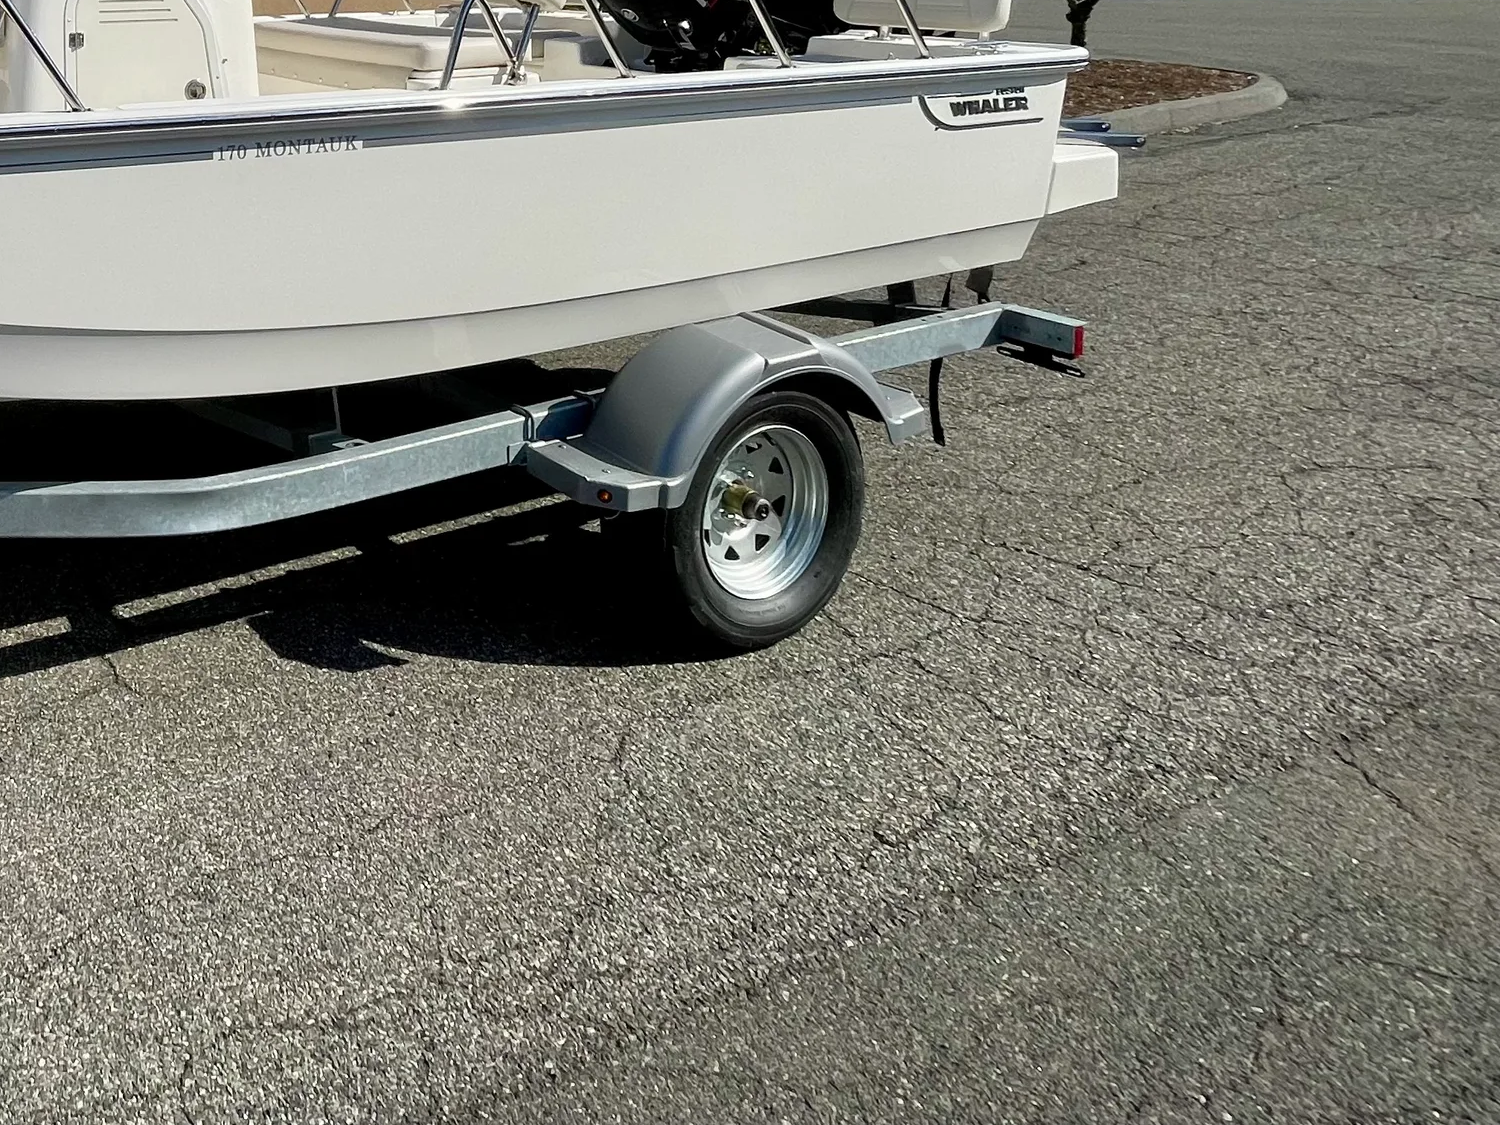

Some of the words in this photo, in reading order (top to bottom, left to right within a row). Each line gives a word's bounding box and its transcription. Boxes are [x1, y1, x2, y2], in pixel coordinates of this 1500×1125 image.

[949, 96, 1029, 117] WHALER
[217, 144, 247, 162] 170
[254, 135, 359, 159] MONTAUK
